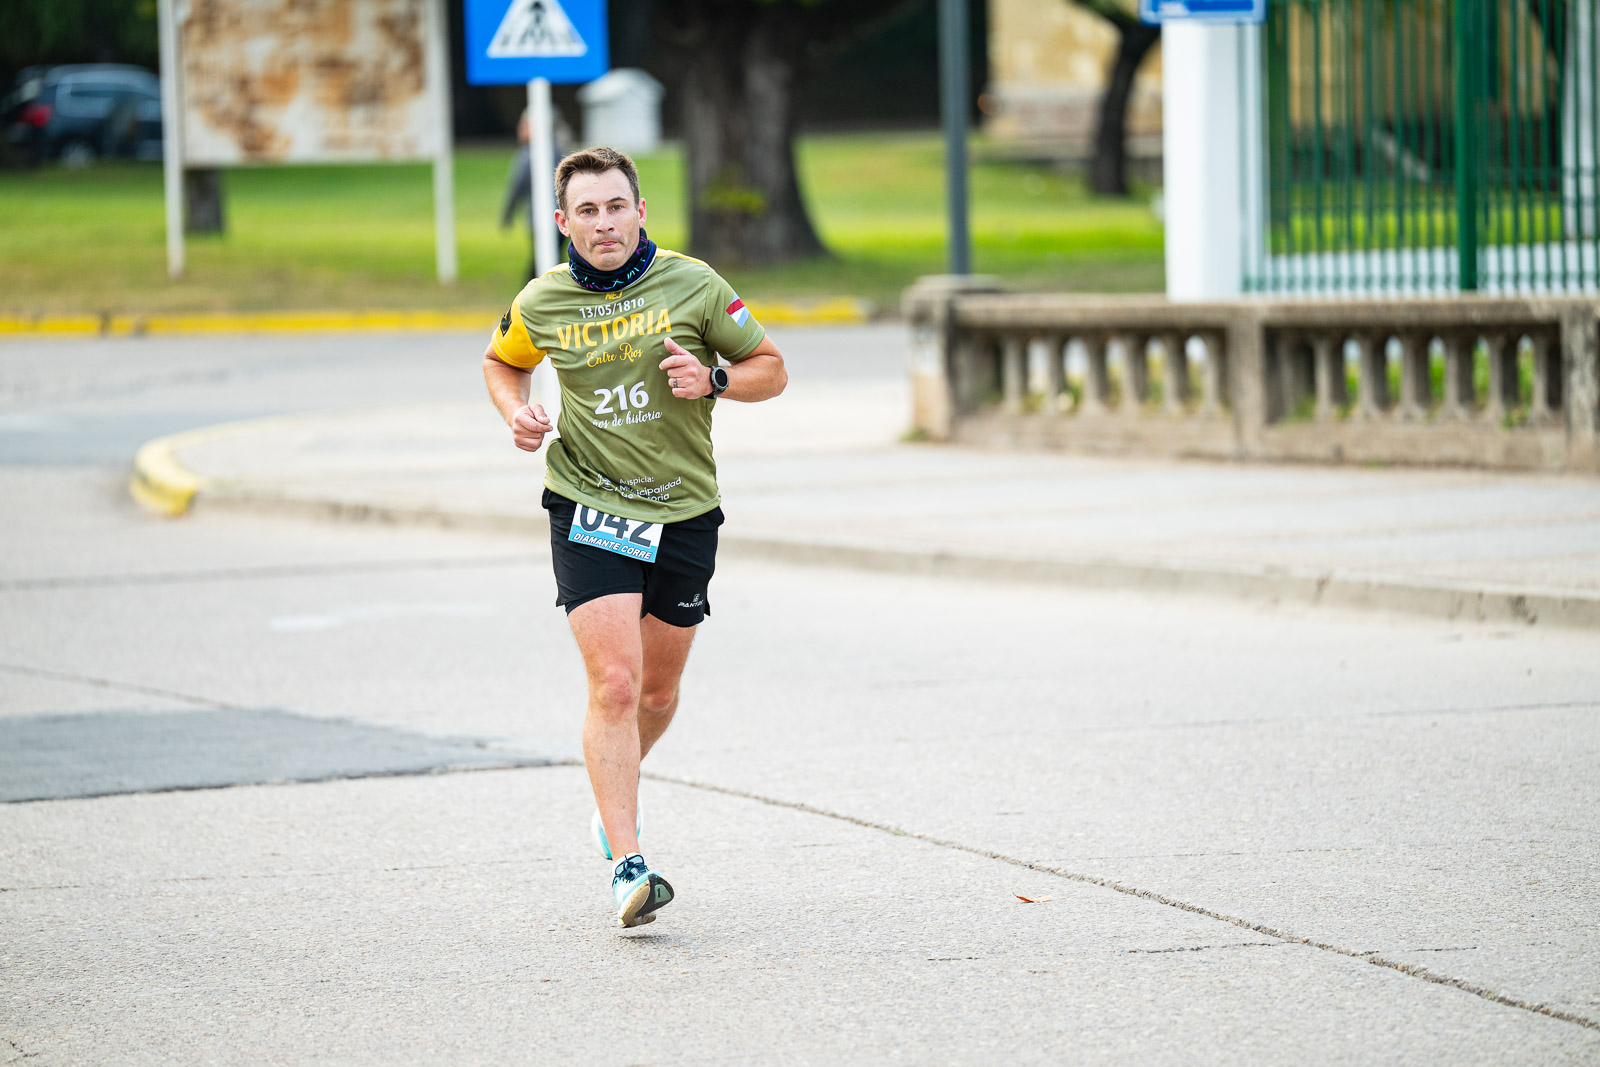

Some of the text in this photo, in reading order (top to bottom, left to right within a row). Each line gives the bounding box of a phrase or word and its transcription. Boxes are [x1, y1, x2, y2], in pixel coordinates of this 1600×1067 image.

[579, 297, 645, 319] 13/05/1810
[556, 308, 672, 351] VICTORIA
[586, 350, 617, 368] Entre
[593, 380, 650, 415] 216
[611, 413, 624, 427] de
[626, 411, 663, 425] historia
[573, 532, 653, 560] DIAMANTE CORRE
